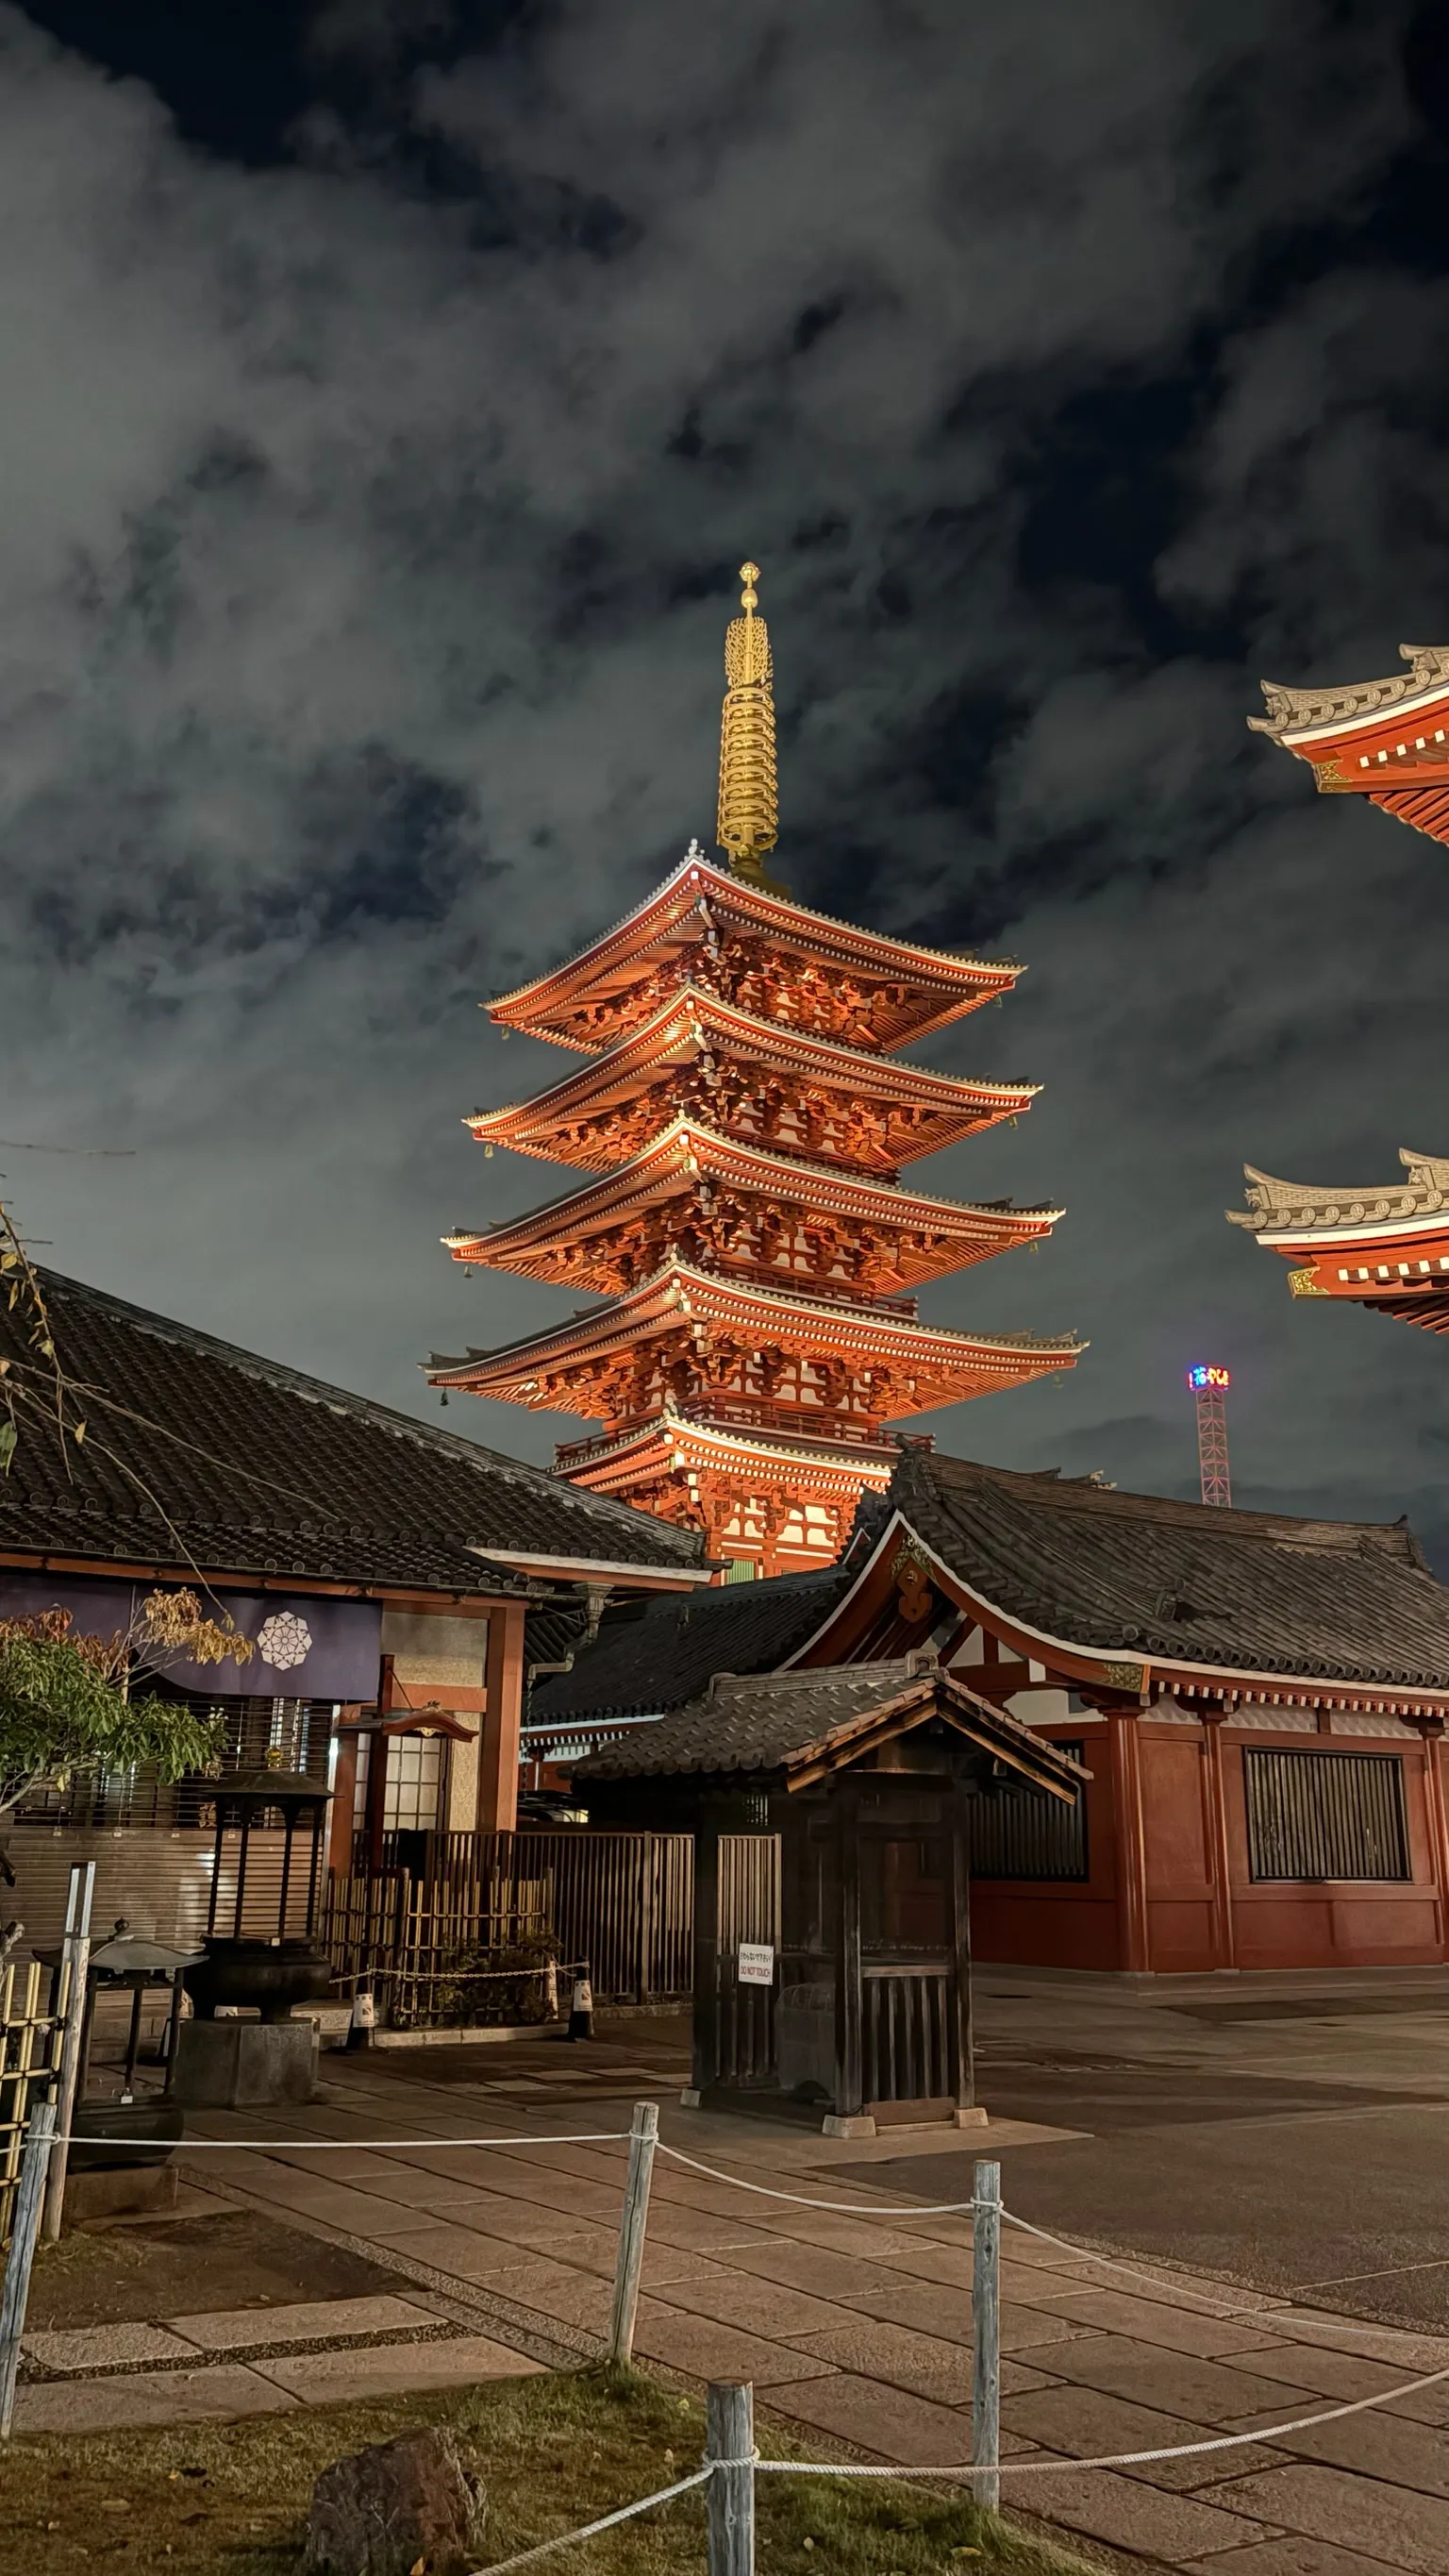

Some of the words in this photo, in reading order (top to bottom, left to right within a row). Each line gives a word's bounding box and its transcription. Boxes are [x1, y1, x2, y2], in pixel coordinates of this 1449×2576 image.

[741, 1965, 746, 1975] DO
[747, 1966, 756, 1976] NOT
[756, 1966, 771, 1978] TOUCH
